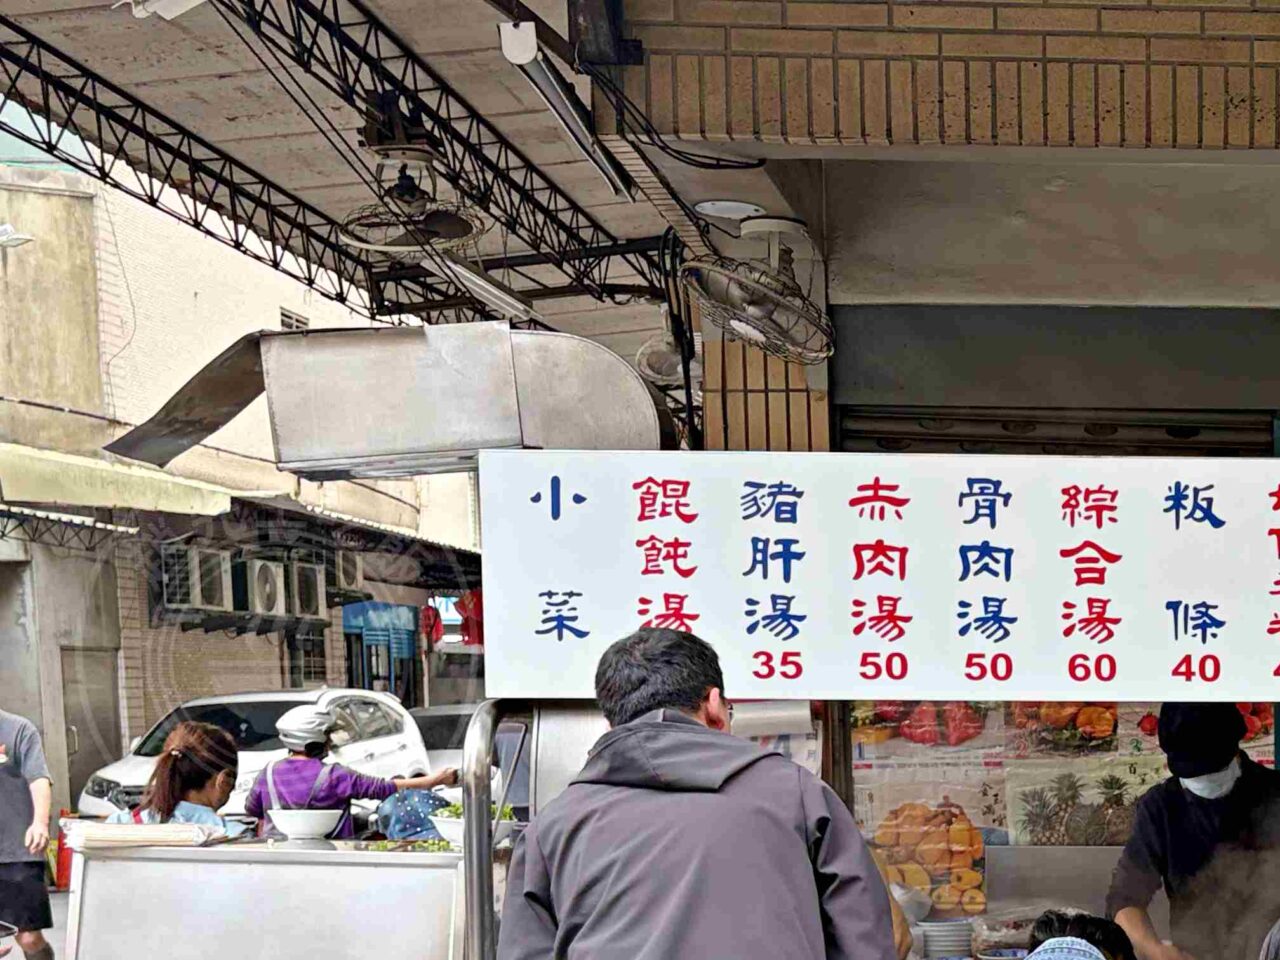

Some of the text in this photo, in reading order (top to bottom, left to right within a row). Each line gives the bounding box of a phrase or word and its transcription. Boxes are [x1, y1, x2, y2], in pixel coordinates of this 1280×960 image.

[740, 480, 807, 641] 豬肝湯
[849, 477, 913, 642] 赤肉湯
[957, 477, 1018, 643] 骨肉湯
[1059, 484, 1123, 644] 綜合湯
[752, 651, 803, 681] 35
[859, 652, 908, 680] 50
[965, 652, 1013, 681] 50
[1067, 653, 1117, 682] 60
[1171, 653, 1221, 682] 40
